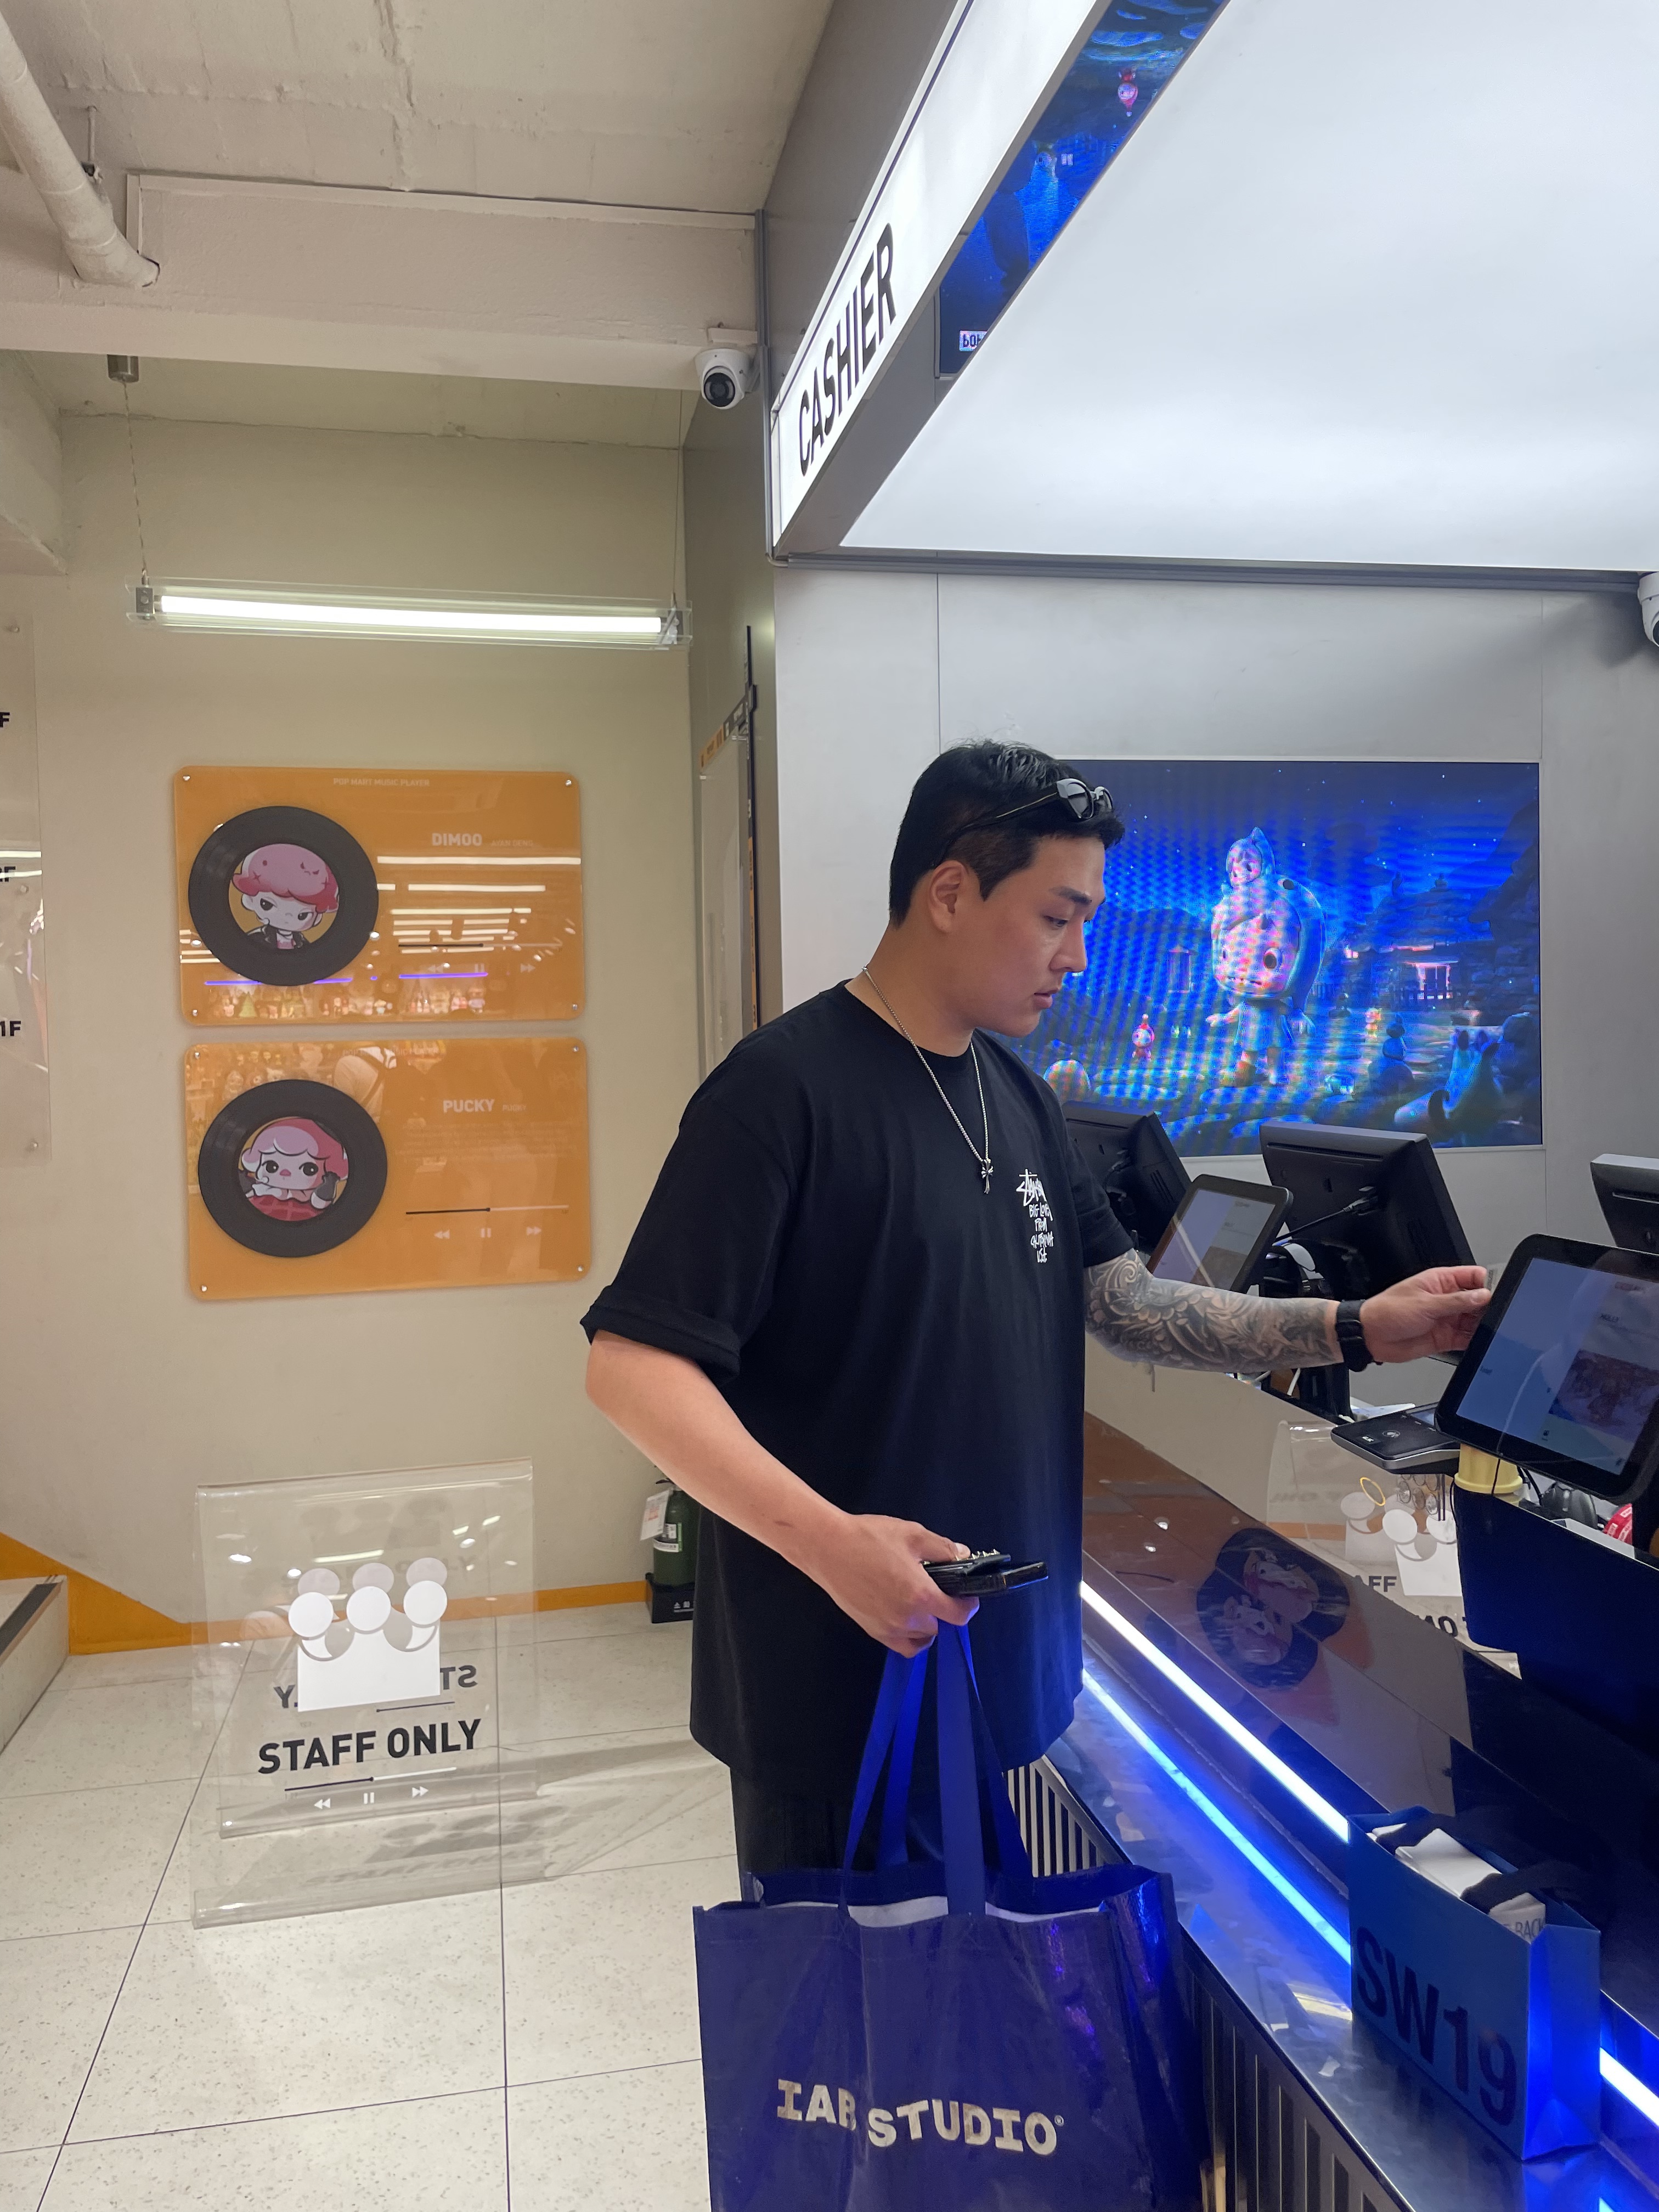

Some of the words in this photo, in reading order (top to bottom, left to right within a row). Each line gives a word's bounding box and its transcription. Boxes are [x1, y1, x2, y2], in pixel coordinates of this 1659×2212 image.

[799, 222, 896, 477] CASHIER
[432, 833, 483, 847] DIMOO
[443, 1098, 495, 1114] PUCKY
[258, 1730, 378, 1775] STAFF
[387, 1718, 482, 1759] ONLY
[1356, 1926, 1517, 2126] SW19
